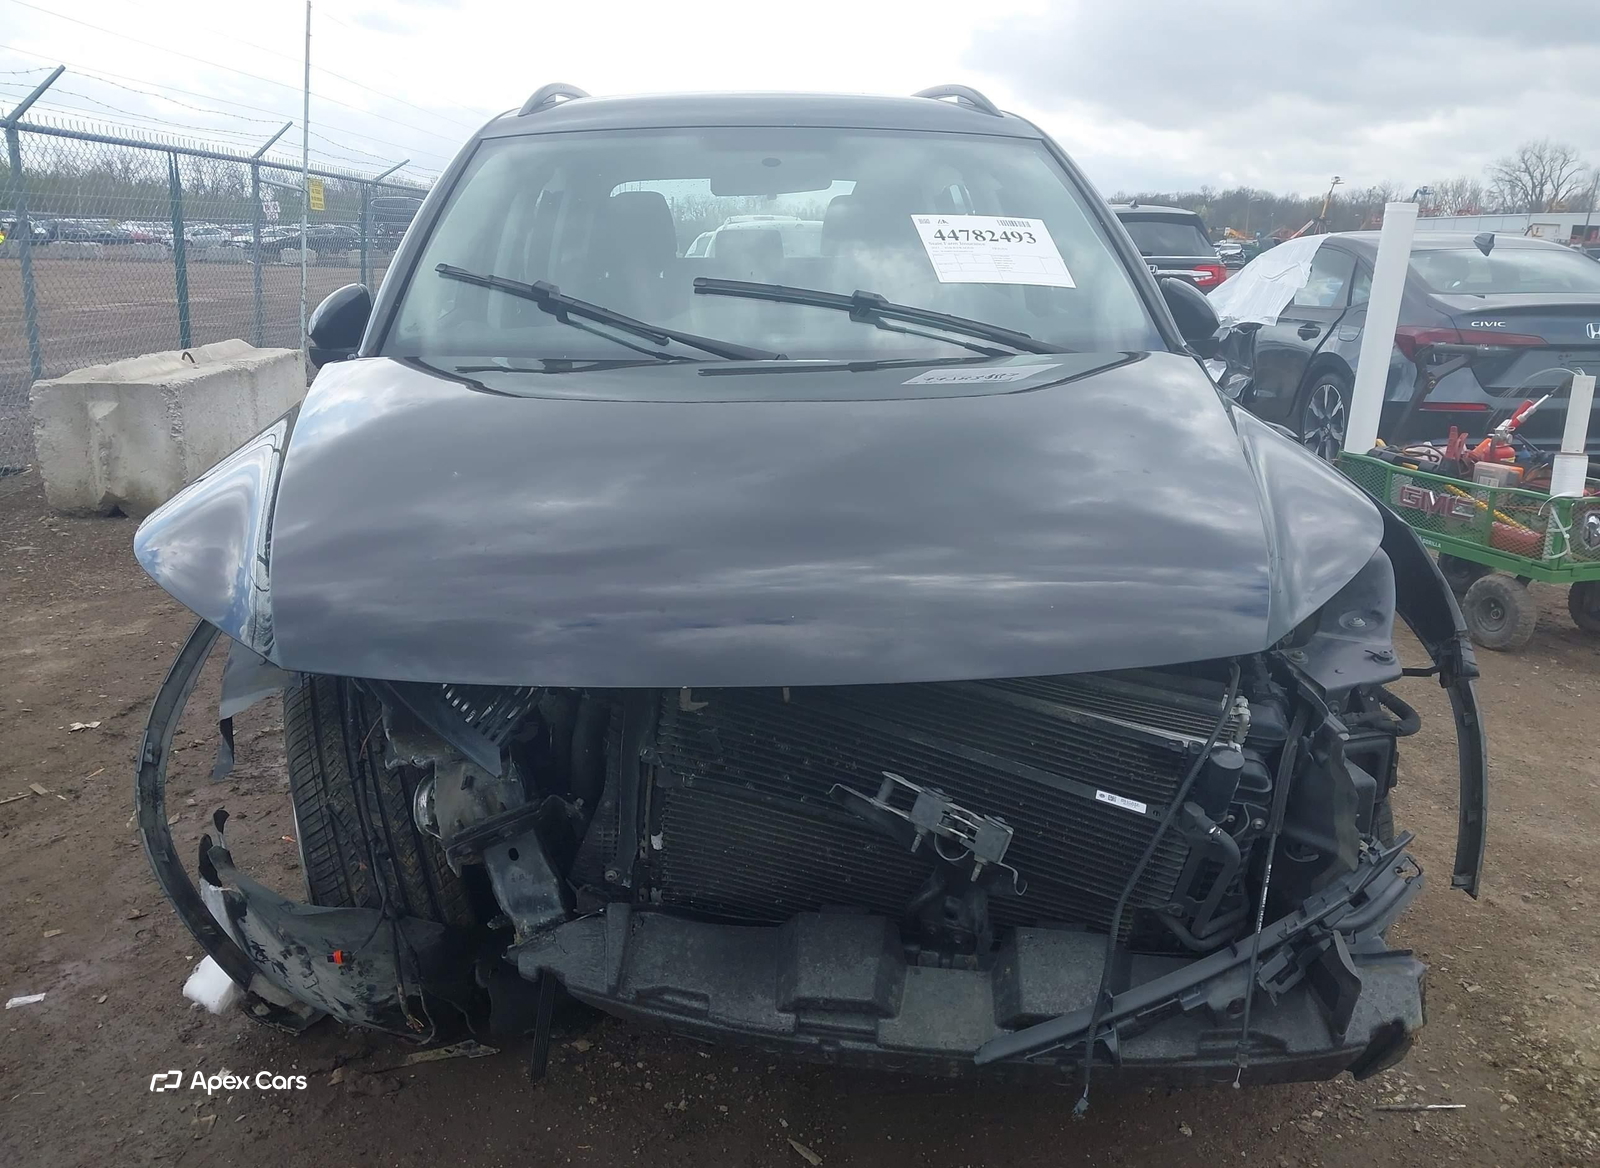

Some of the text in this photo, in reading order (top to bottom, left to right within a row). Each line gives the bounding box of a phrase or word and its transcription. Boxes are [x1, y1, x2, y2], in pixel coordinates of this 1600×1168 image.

[934, 229, 1037, 244] 44782493
[1471, 320, 1507, 328] CIVIC
[1399, 485, 1475, 521] GMC
[1421, 538, 1441, 548] GORILLA
